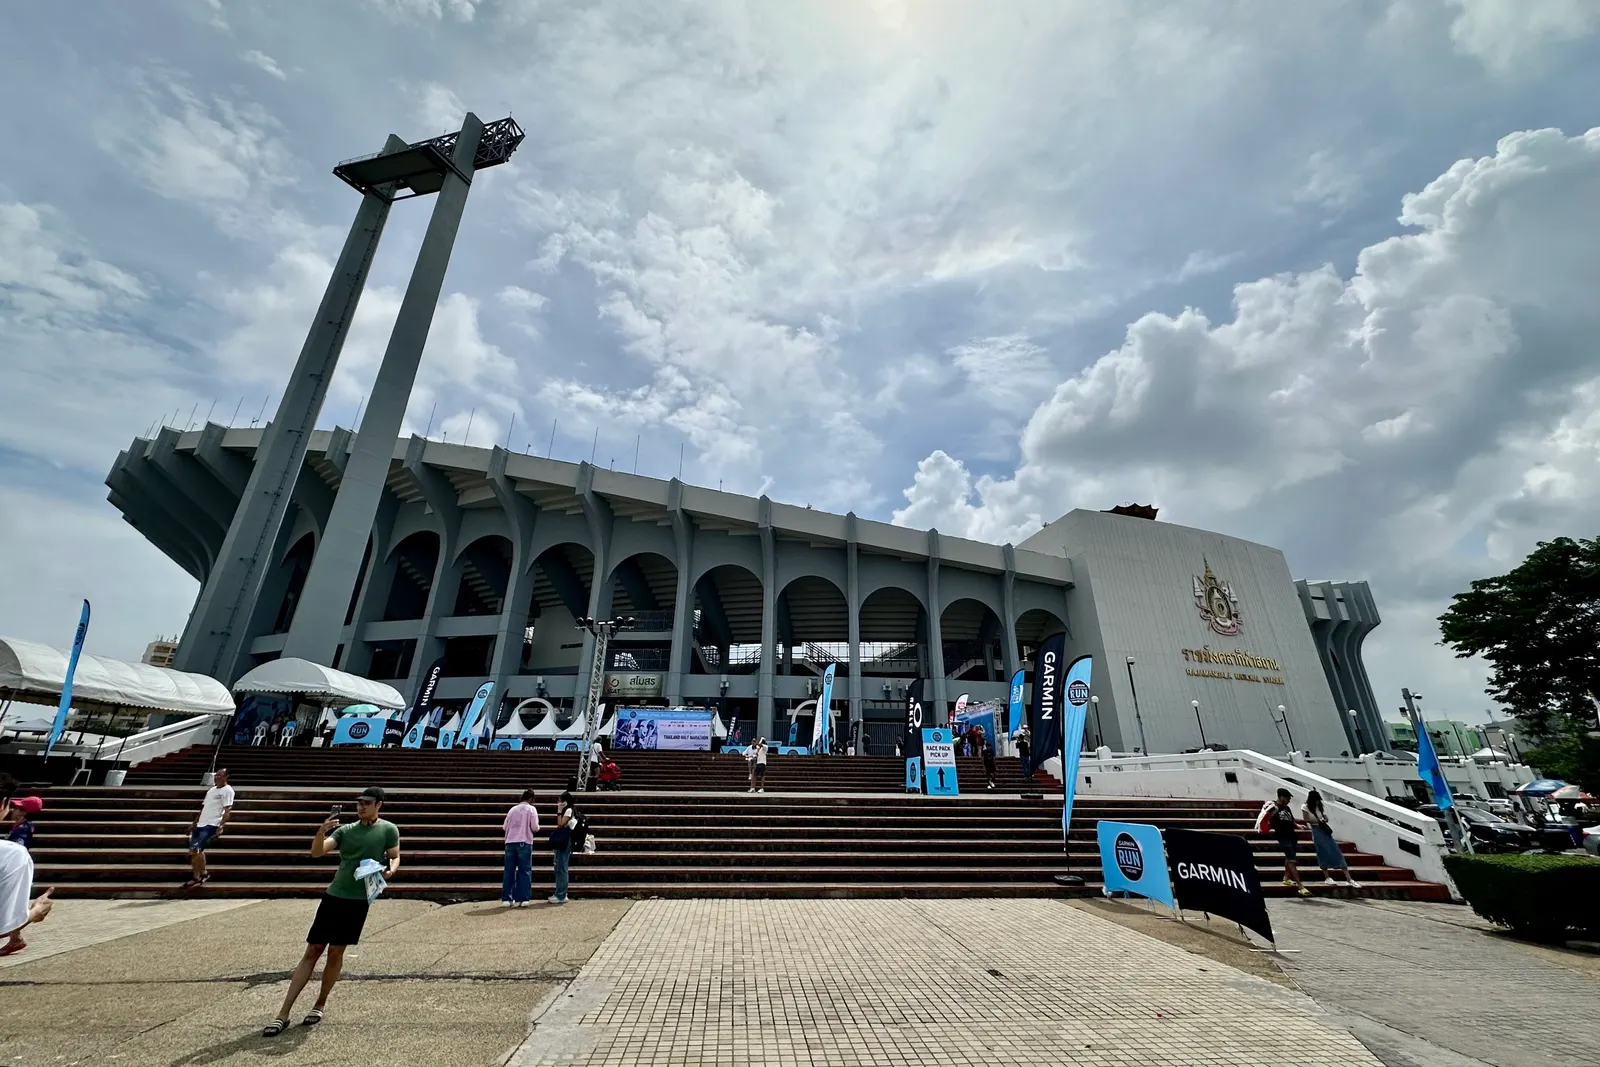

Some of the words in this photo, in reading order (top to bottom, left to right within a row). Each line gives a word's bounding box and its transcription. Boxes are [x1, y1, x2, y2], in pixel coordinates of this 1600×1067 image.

[421, 666, 440, 705] GARMIN
[1042, 651, 1056, 720] GARMIN
[1069, 689, 1088, 699] RUN
[350, 727, 368, 735] RUN
[1118, 849, 1141, 867] RUN
[1177, 862, 1248, 893] GARMIN
